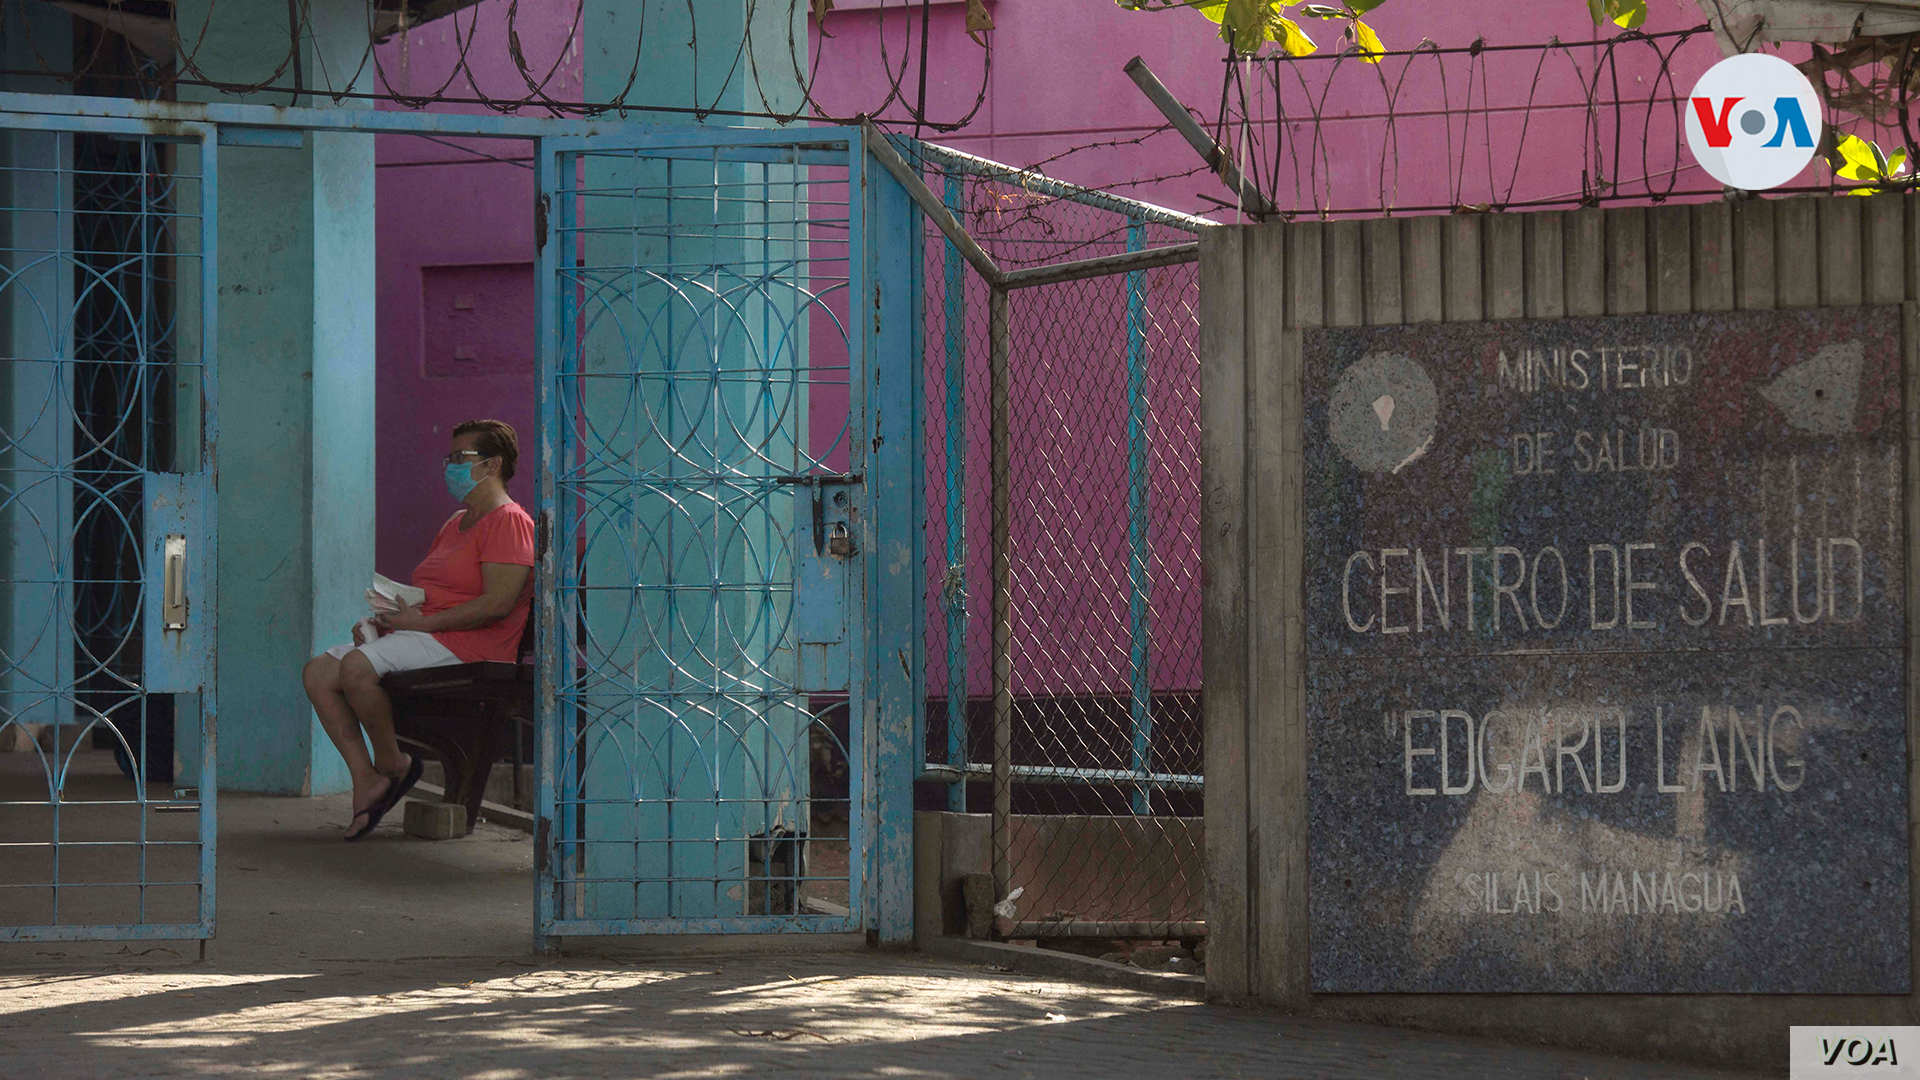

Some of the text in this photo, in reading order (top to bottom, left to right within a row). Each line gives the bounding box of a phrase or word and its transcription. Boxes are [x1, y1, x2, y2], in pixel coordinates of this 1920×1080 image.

[1499, 345, 1693, 392] MINISTERIO
[1513, 428, 1680, 475] DE SALUD
[1342, 537, 1864, 635] CENTRO DE SALUD
[1656, 703, 1807, 794] LANG
[1465, 870, 1747, 915] SILAIS MANAGUA
